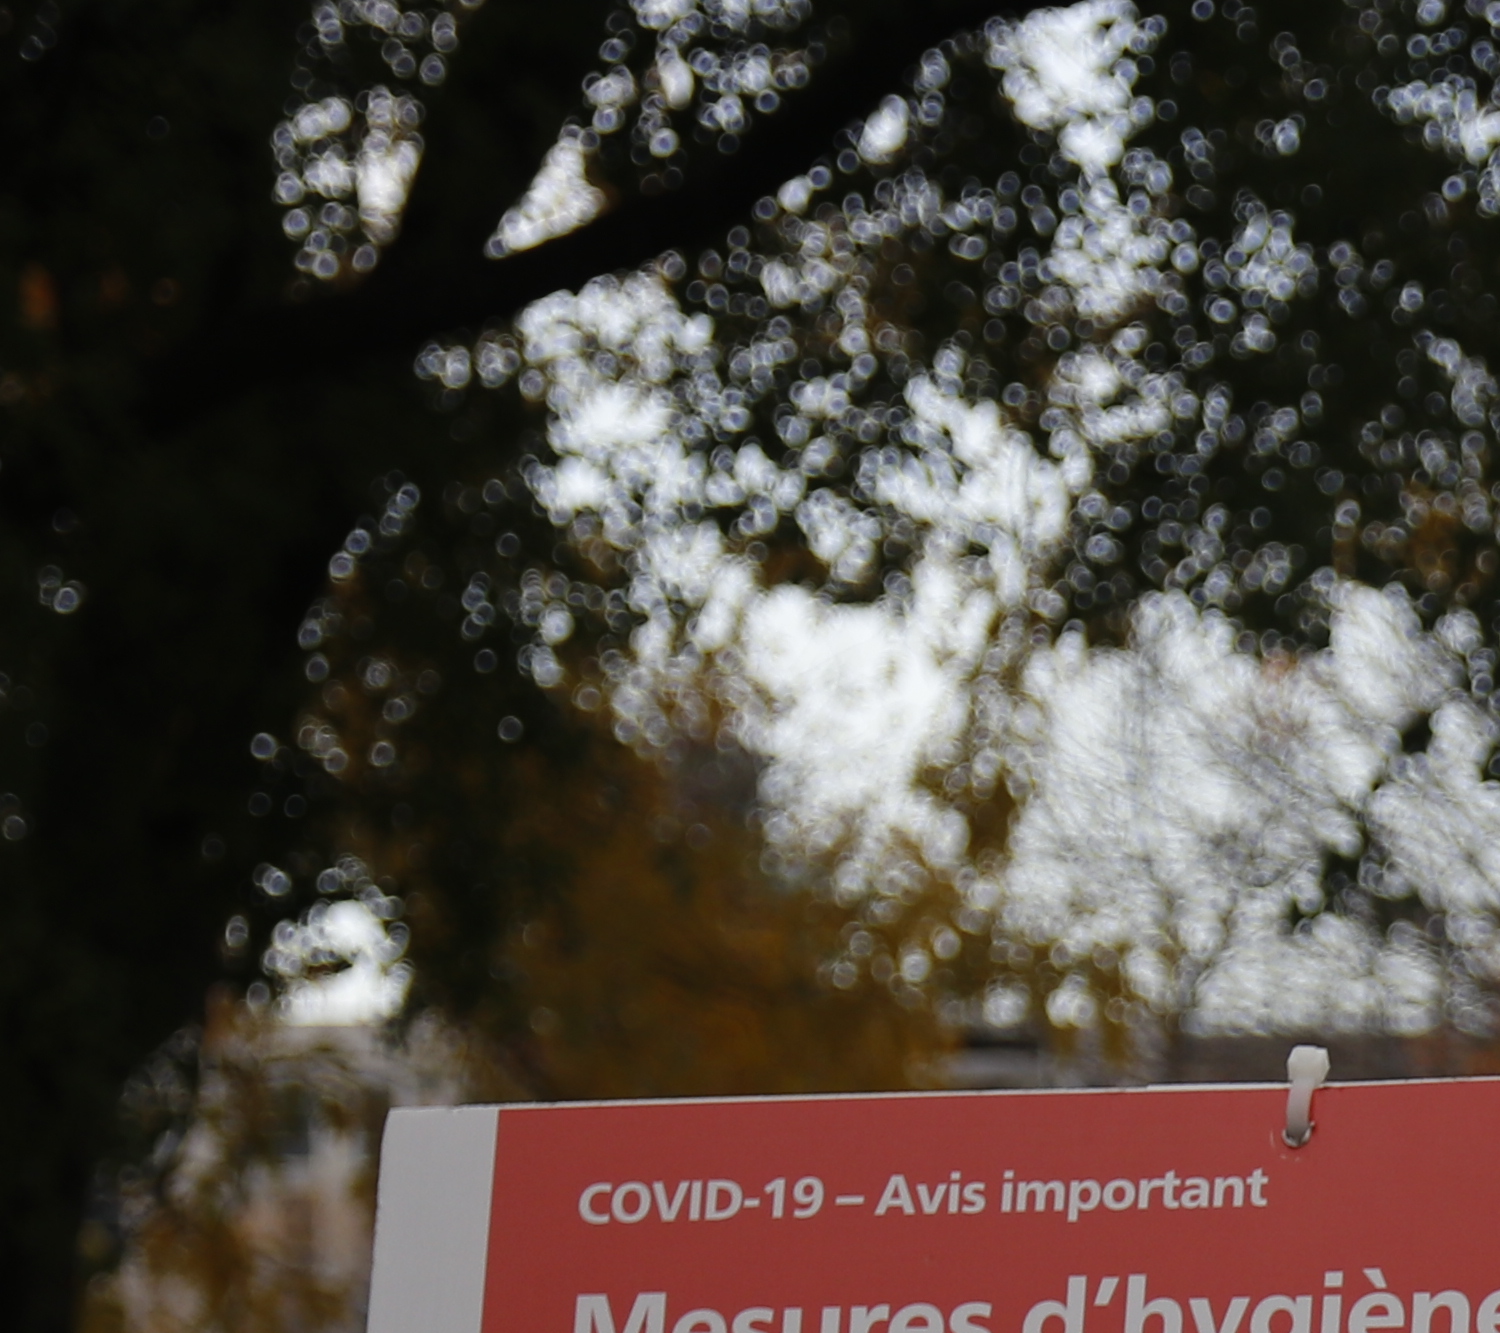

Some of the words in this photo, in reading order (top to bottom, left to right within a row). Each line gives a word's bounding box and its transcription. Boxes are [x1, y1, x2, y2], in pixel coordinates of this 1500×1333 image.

[578, 1175, 825, 1225] COVID-19
[873, 1170, 987, 1217] Avis
[1000, 1166, 1270, 1224] important
